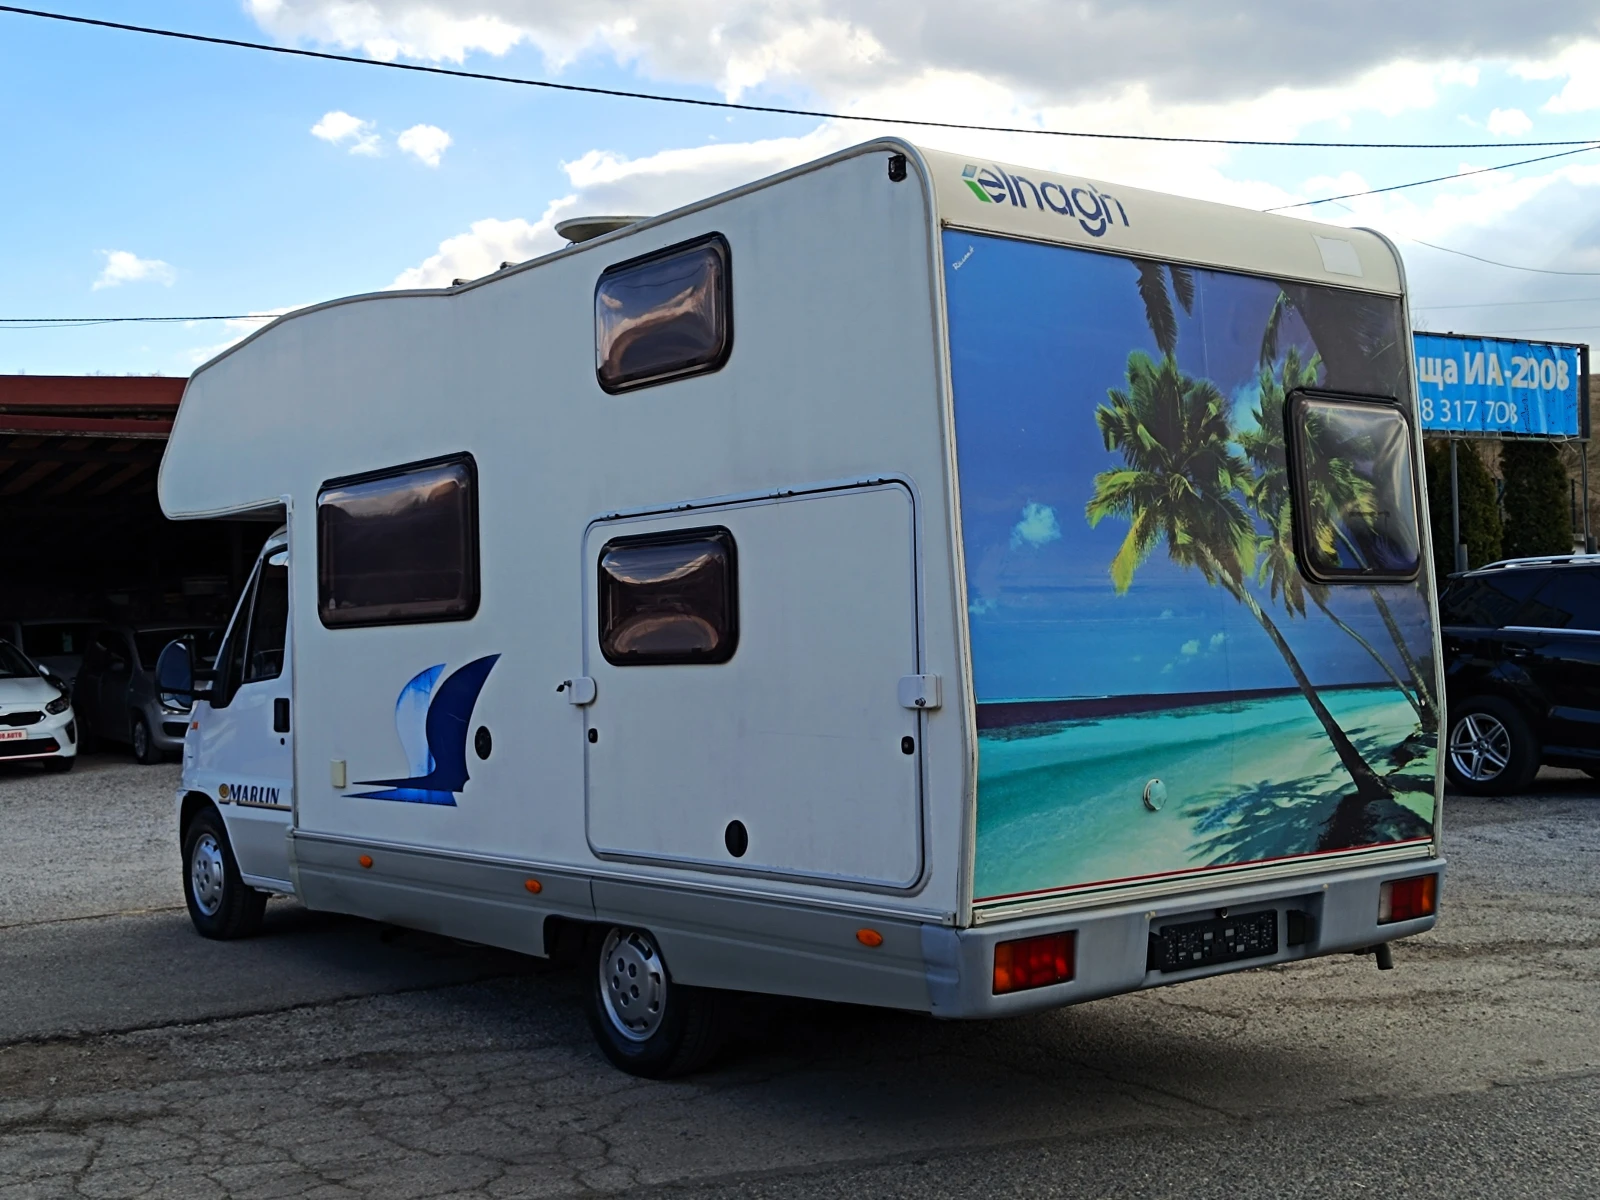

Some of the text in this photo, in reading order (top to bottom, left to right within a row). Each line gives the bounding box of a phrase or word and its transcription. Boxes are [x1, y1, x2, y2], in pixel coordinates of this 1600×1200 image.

[1416, 351, 1570, 391] ща ИА-2008
[1440, 399, 1477, 422] 317
[1485, 401, 1518, 424] 708
[229, 783, 280, 805] MARLIN
